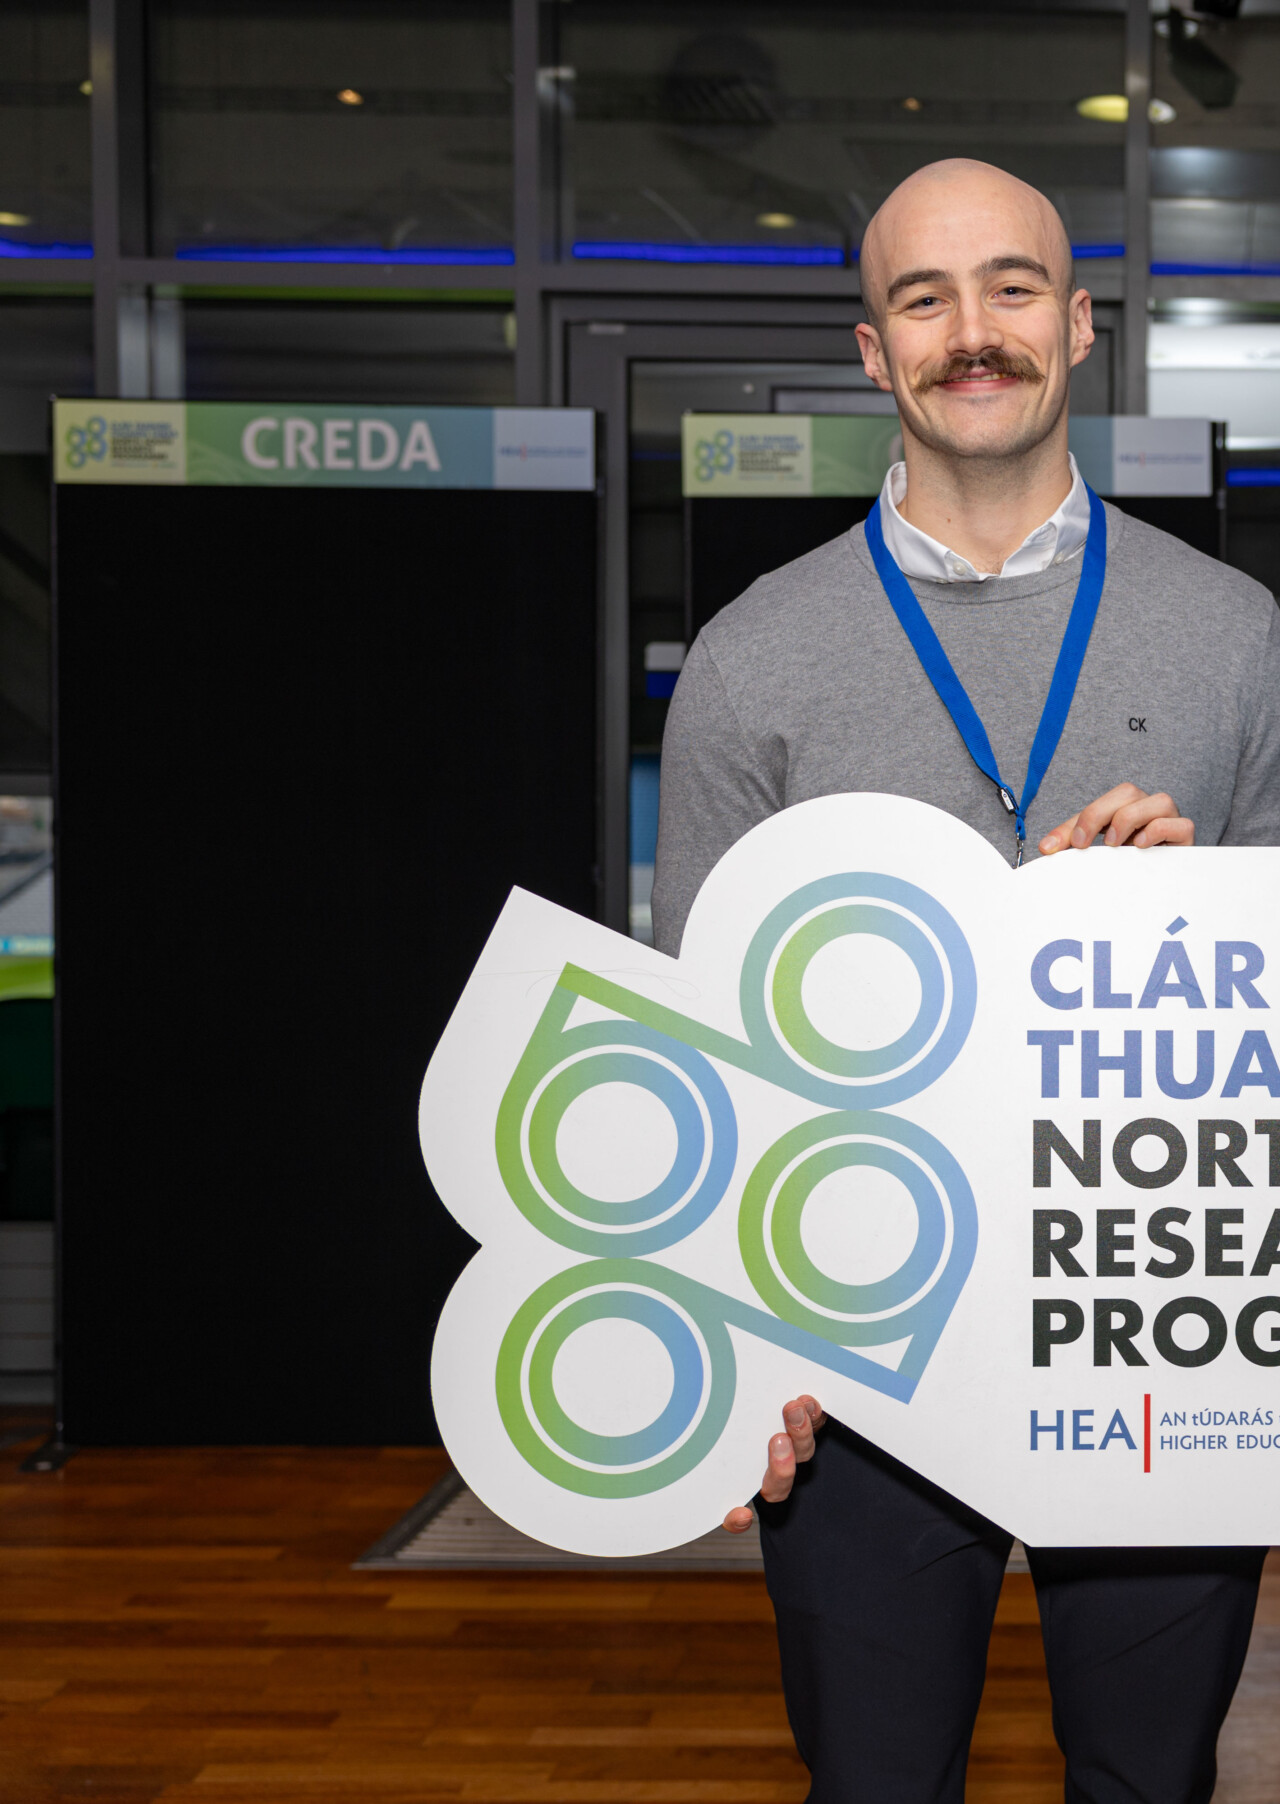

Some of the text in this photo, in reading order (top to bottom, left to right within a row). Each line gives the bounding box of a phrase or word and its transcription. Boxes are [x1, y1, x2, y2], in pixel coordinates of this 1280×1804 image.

[242, 417, 441, 471] CREDA
[1128, 717, 1147, 733] CK
[1030, 916, 1270, 1011] CLÁR
[1029, 1408, 1138, 1451] HEA
[1160, 1411, 1187, 1427] AN
[1192, 1407, 1274, 1427] tÚDARÁS
[1160, 1434, 1229, 1450] HIGHER
